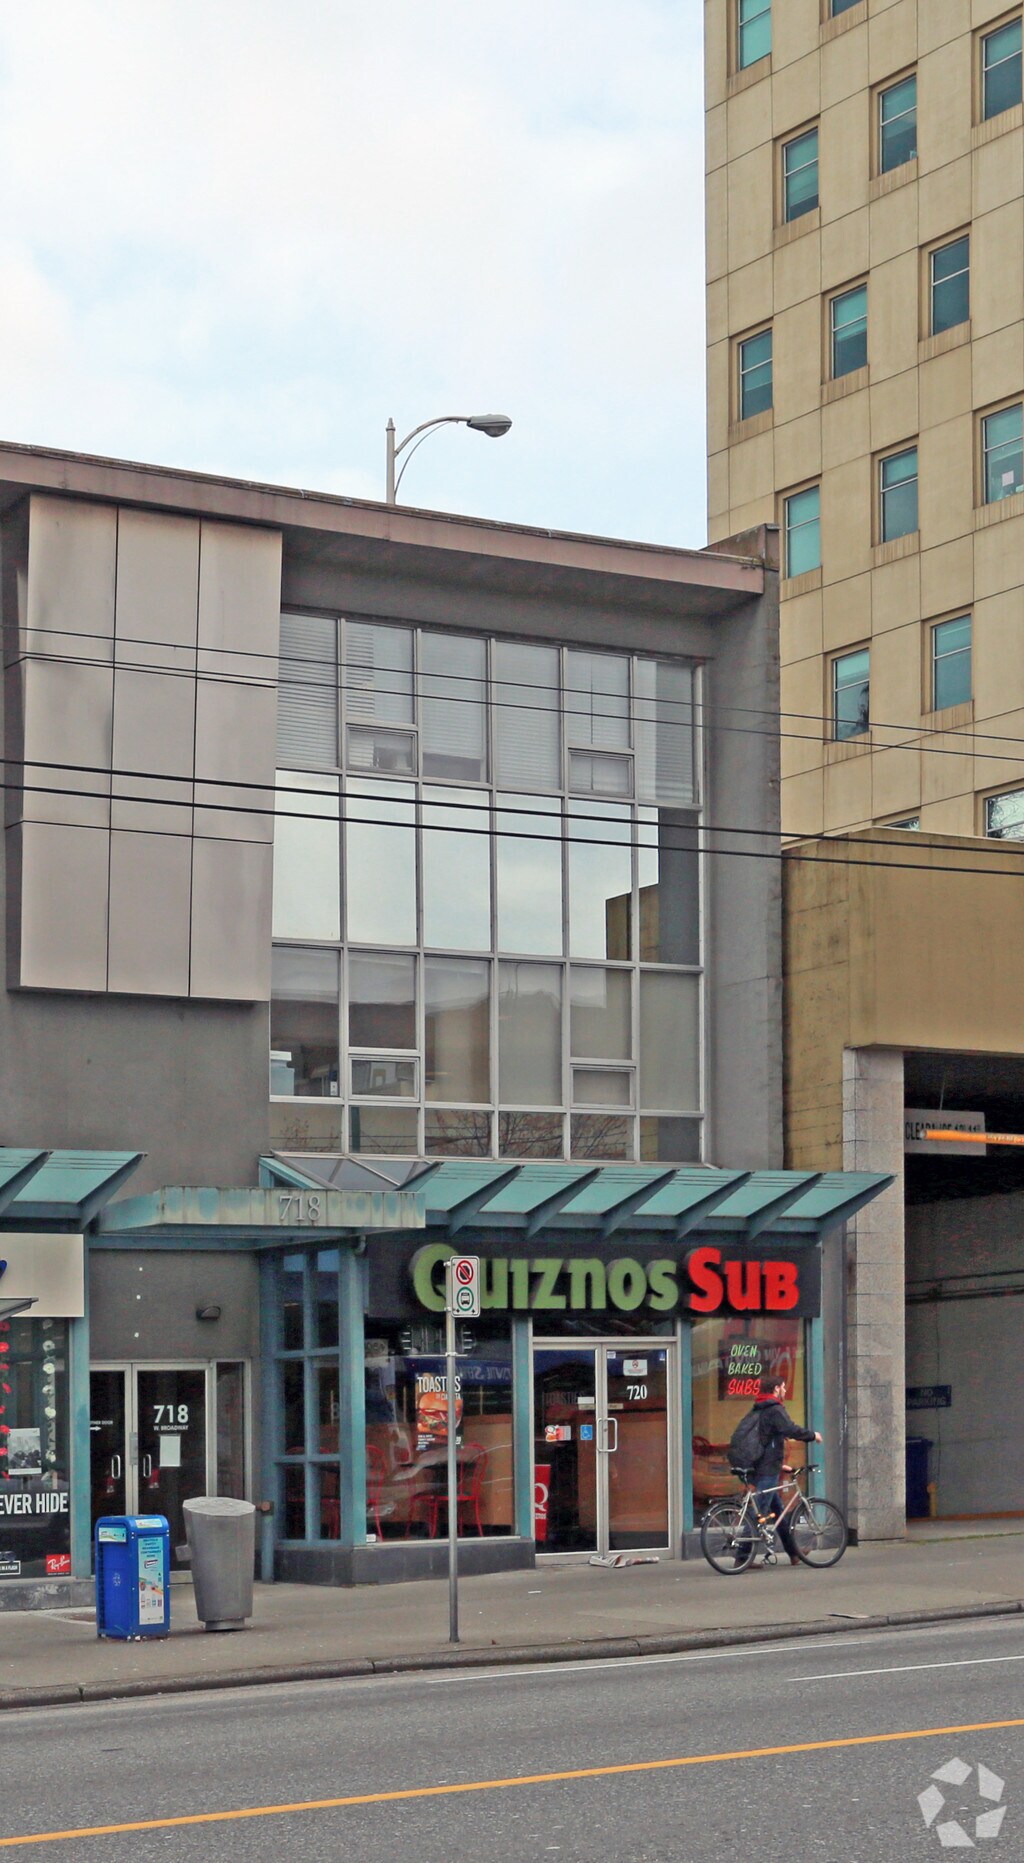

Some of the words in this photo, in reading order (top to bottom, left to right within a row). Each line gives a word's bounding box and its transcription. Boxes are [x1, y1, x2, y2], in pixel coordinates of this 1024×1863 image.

[279, 1195, 321, 1221] 718
[730, 1344, 758, 1358] OVEN
[727, 1362, 763, 1376] BAKED
[417, 1376, 461, 1393] TOASTS
[626, 1384, 648, 1401] 720
[727, 1378, 762, 1396] SUBS
[153, 1404, 189, 1424] 718
[36, 1492, 68, 1513] HIDE
